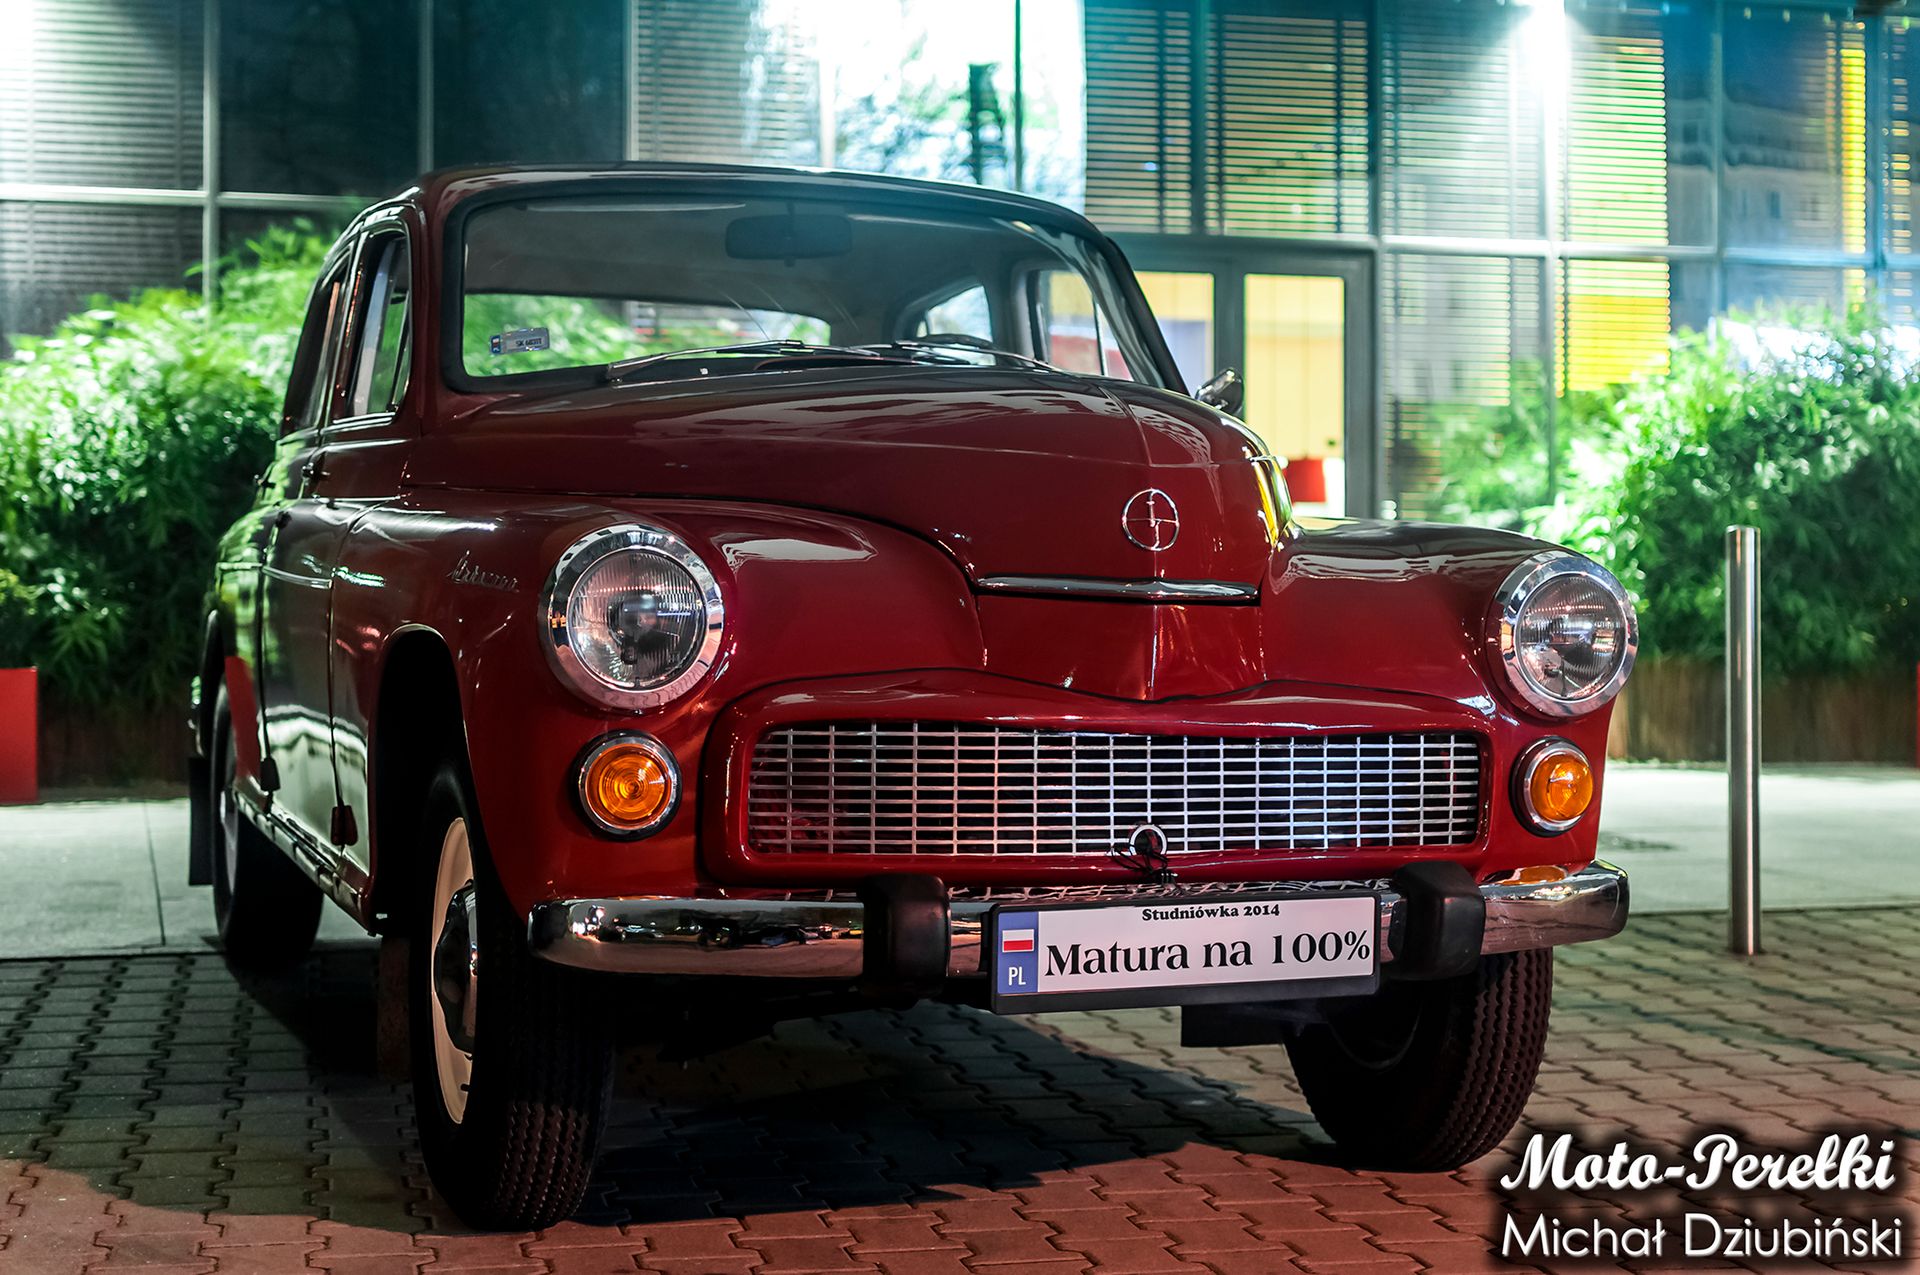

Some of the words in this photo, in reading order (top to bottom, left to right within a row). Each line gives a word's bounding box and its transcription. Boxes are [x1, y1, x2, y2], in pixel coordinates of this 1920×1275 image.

[1142, 904, 1240, 921] Studniówka
[1244, 903, 1281, 918] 2014
[1043, 940, 1190, 977] Matura
[1202, 940, 1254, 968] na
[1271, 929, 1371, 964] 100%
[1008, 966, 1027, 986] PL
